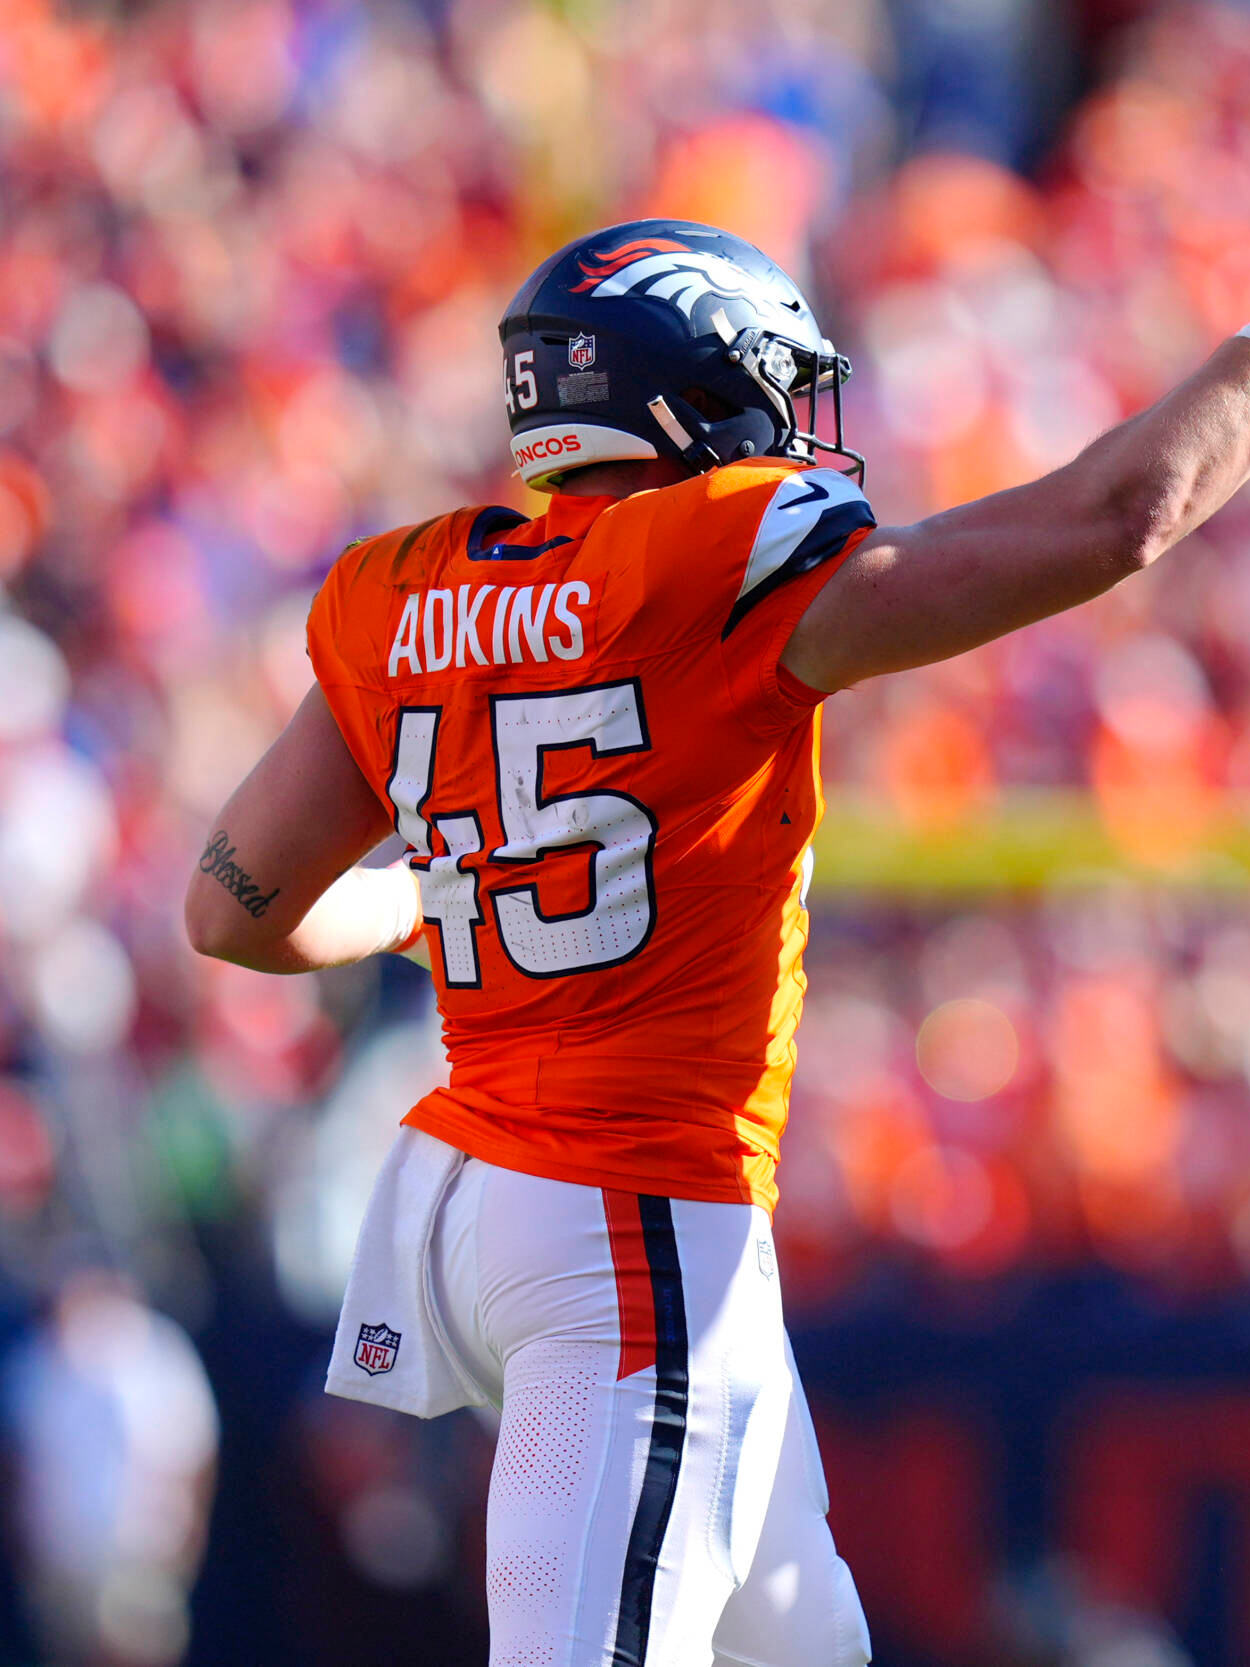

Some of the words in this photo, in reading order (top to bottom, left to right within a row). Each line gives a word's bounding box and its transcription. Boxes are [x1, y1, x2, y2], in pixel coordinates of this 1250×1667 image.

[503, 350, 538, 415] 45
[572, 350, 592, 364] NFL
[388, 580, 591, 677] ADKINS
[386, 676, 660, 989] 45
[200, 830, 280, 918] Blessed
[358, 1342, 390, 1369] NFL
